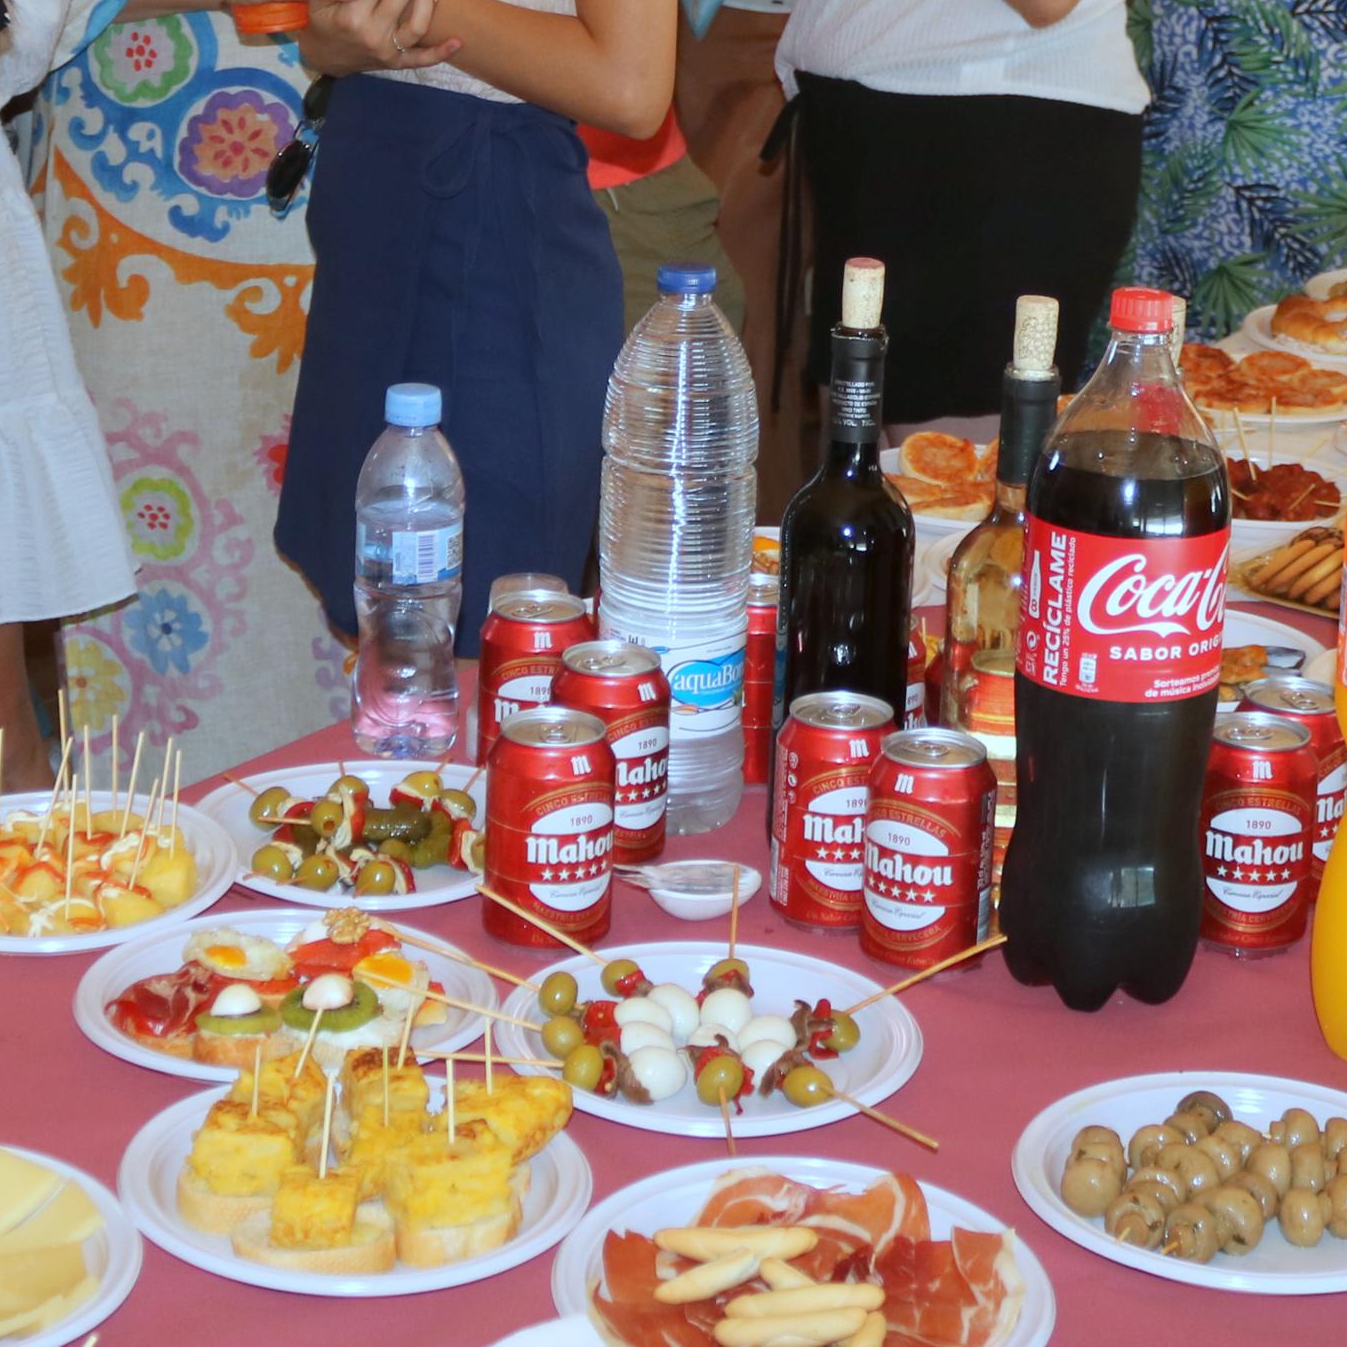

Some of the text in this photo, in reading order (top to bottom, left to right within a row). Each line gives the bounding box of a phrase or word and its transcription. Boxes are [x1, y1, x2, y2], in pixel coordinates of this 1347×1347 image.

[1043, 531, 1066, 685] RECÍCLAME
[1064, 614, 1071, 626] de
[1062, 648, 1069, 659] un
[1110, 634, 1221, 661] SABOR ORIG
[1059, 662, 1070, 687] Tengo
[1144, 685, 1192, 698] de música
[638, 738, 658, 751] 1890
[570, 814, 593, 828] 1890
[1246, 819, 1272, 830] 1890
[887, 831, 911, 846] 1890
[1205, 830, 1304, 866] Mahou
[864, 841, 954, 886] Mahou
